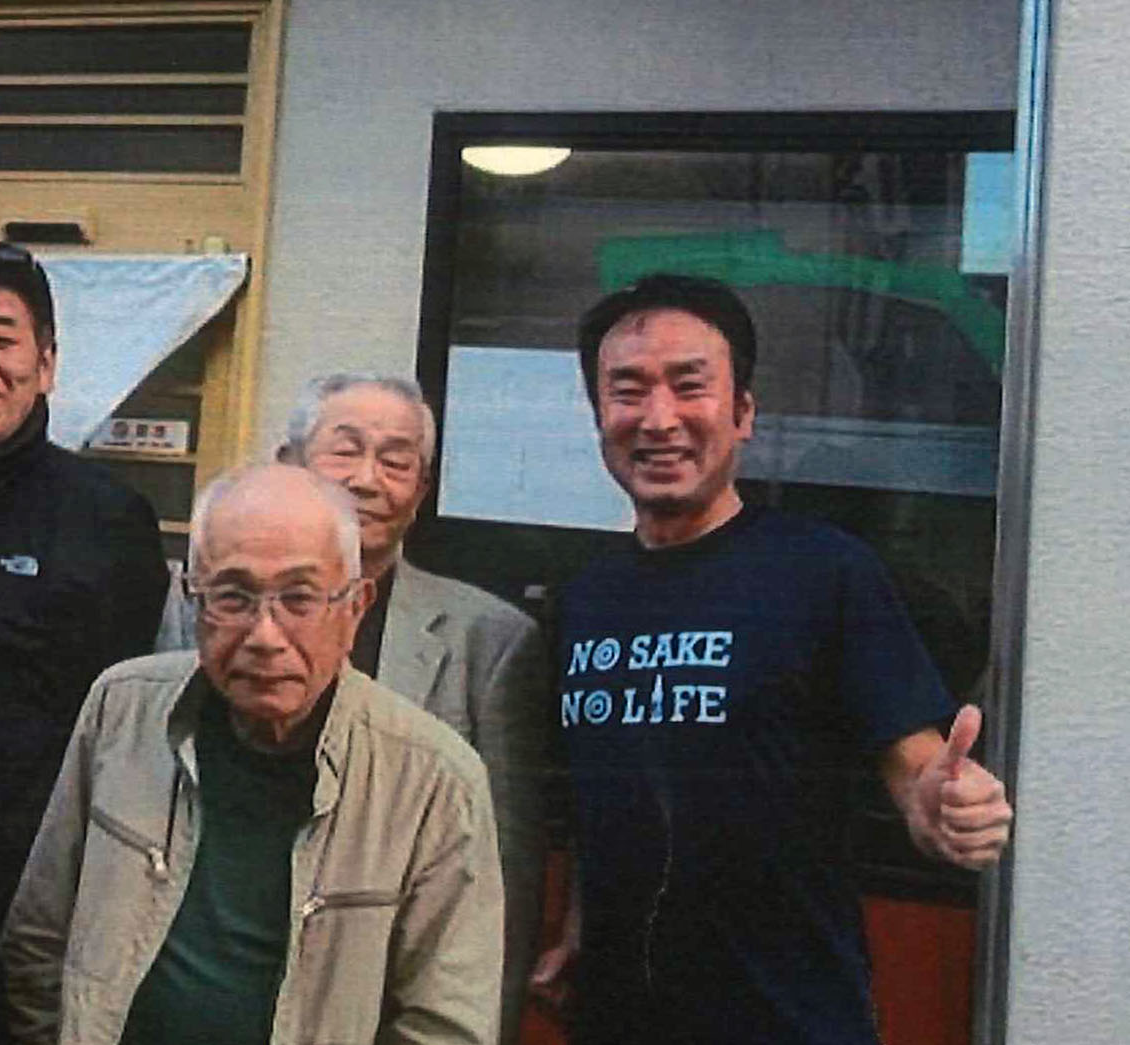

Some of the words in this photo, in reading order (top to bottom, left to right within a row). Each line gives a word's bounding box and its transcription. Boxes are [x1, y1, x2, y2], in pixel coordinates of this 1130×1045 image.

[567, 637, 620, 675] NO
[628, 631, 733, 670] SAKE
[561, 690, 613, 728] NO
[621, 674, 727, 724] LIFE
